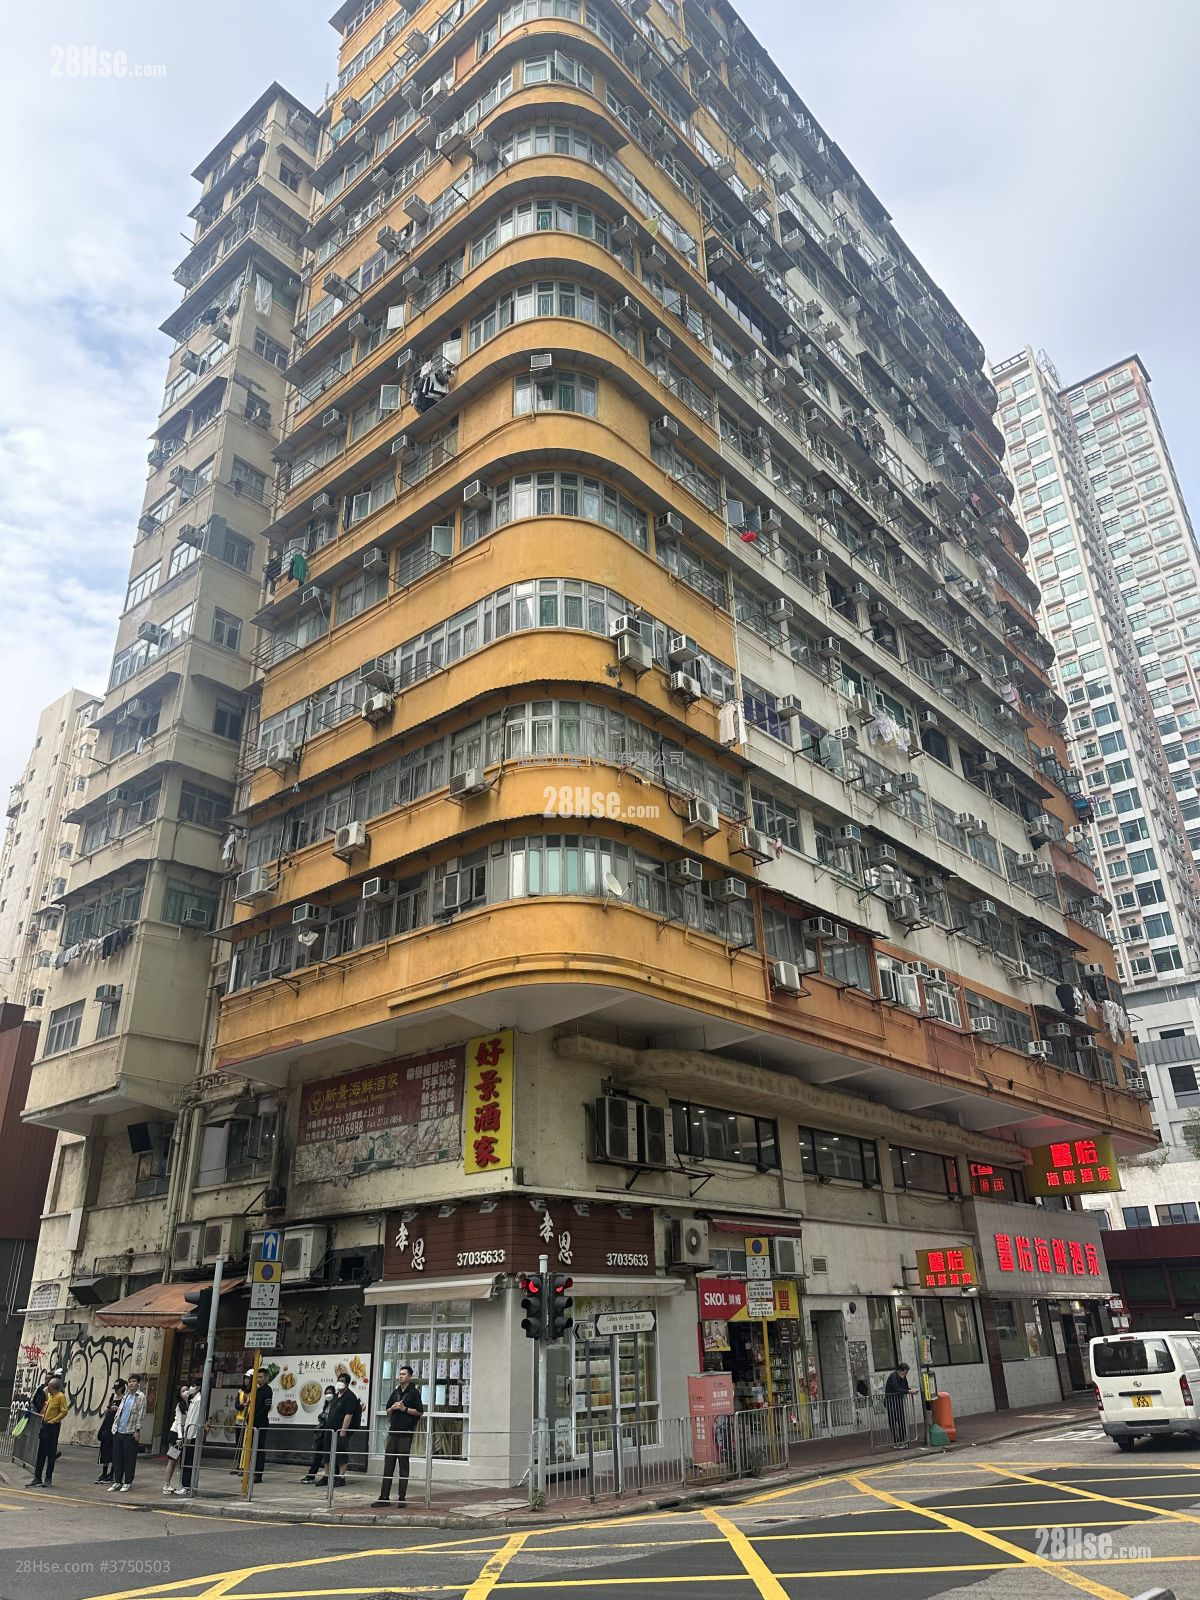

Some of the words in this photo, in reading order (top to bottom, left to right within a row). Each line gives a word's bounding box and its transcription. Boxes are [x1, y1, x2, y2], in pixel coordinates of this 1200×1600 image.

[325, 1072, 399, 1102] 新景海鮮酒家
[473, 1037, 504, 1168] 好景酒家
[1050, 1140, 1099, 1168] 馨怡
[1046, 1166, 1112, 1187] 海鮮酒家
[456, 1249, 505, 1267] 37035633
[606, 1253, 649, 1266] 37035633
[761, 1257, 766, 1266] 7
[927, 1250, 965, 1273] 馨怡
[994, 1233, 1101, 1276] 馨怡海鮮酒家
[762, 1269, 767, 1278] 7
[926, 1272, 972, 1286] 海鮮酒家
[270, 1284, 276, 1294] 7
[268, 1297, 275, 1307] 7
[704, 1292, 728, 1306] SKOL
